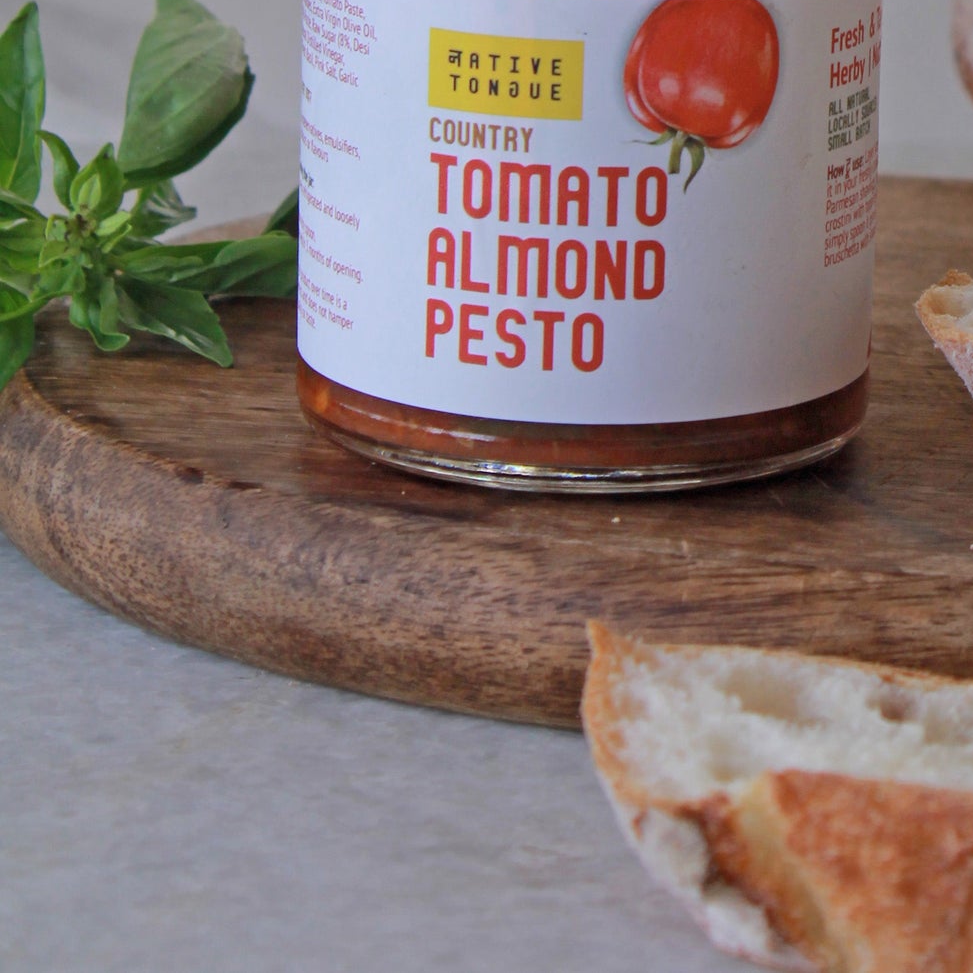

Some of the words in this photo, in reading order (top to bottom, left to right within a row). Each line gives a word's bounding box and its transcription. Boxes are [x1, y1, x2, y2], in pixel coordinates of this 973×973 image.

[344, 0, 366, 20] Paste,
[343, 16, 361, 36] Olive
[363, 23, 378, 42] Oil,
[830, 18, 865, 55] Fresh
[353, 37, 370, 55] Desi
[339, 68, 359, 88] Garlic
[829, 55, 866, 89] Herby
[829, 98, 843, 117] ALL
[828, 109, 859, 134] LOCALLY
[429, 116, 534, 154] COUNTRY
[828, 130, 852, 151] SMALL
[827, 164, 845, 181] How
[430, 152, 668, 227] TOMATO
[834, 179, 842, 195] in
[844, 176, 858, 196] your
[826, 192, 860, 215] Parmesan
[334, 206, 361, 232] loosely
[825, 230, 849, 252] simply
[325, 255, 333, 268] of
[333, 260, 364, 284] opening.
[427, 226, 666, 300] ALMOND
[321, 287, 335, 306] time
[342, 299, 348, 311] a
[328, 307, 354, 331] hamper
[425, 297, 605, 373] PESTO
